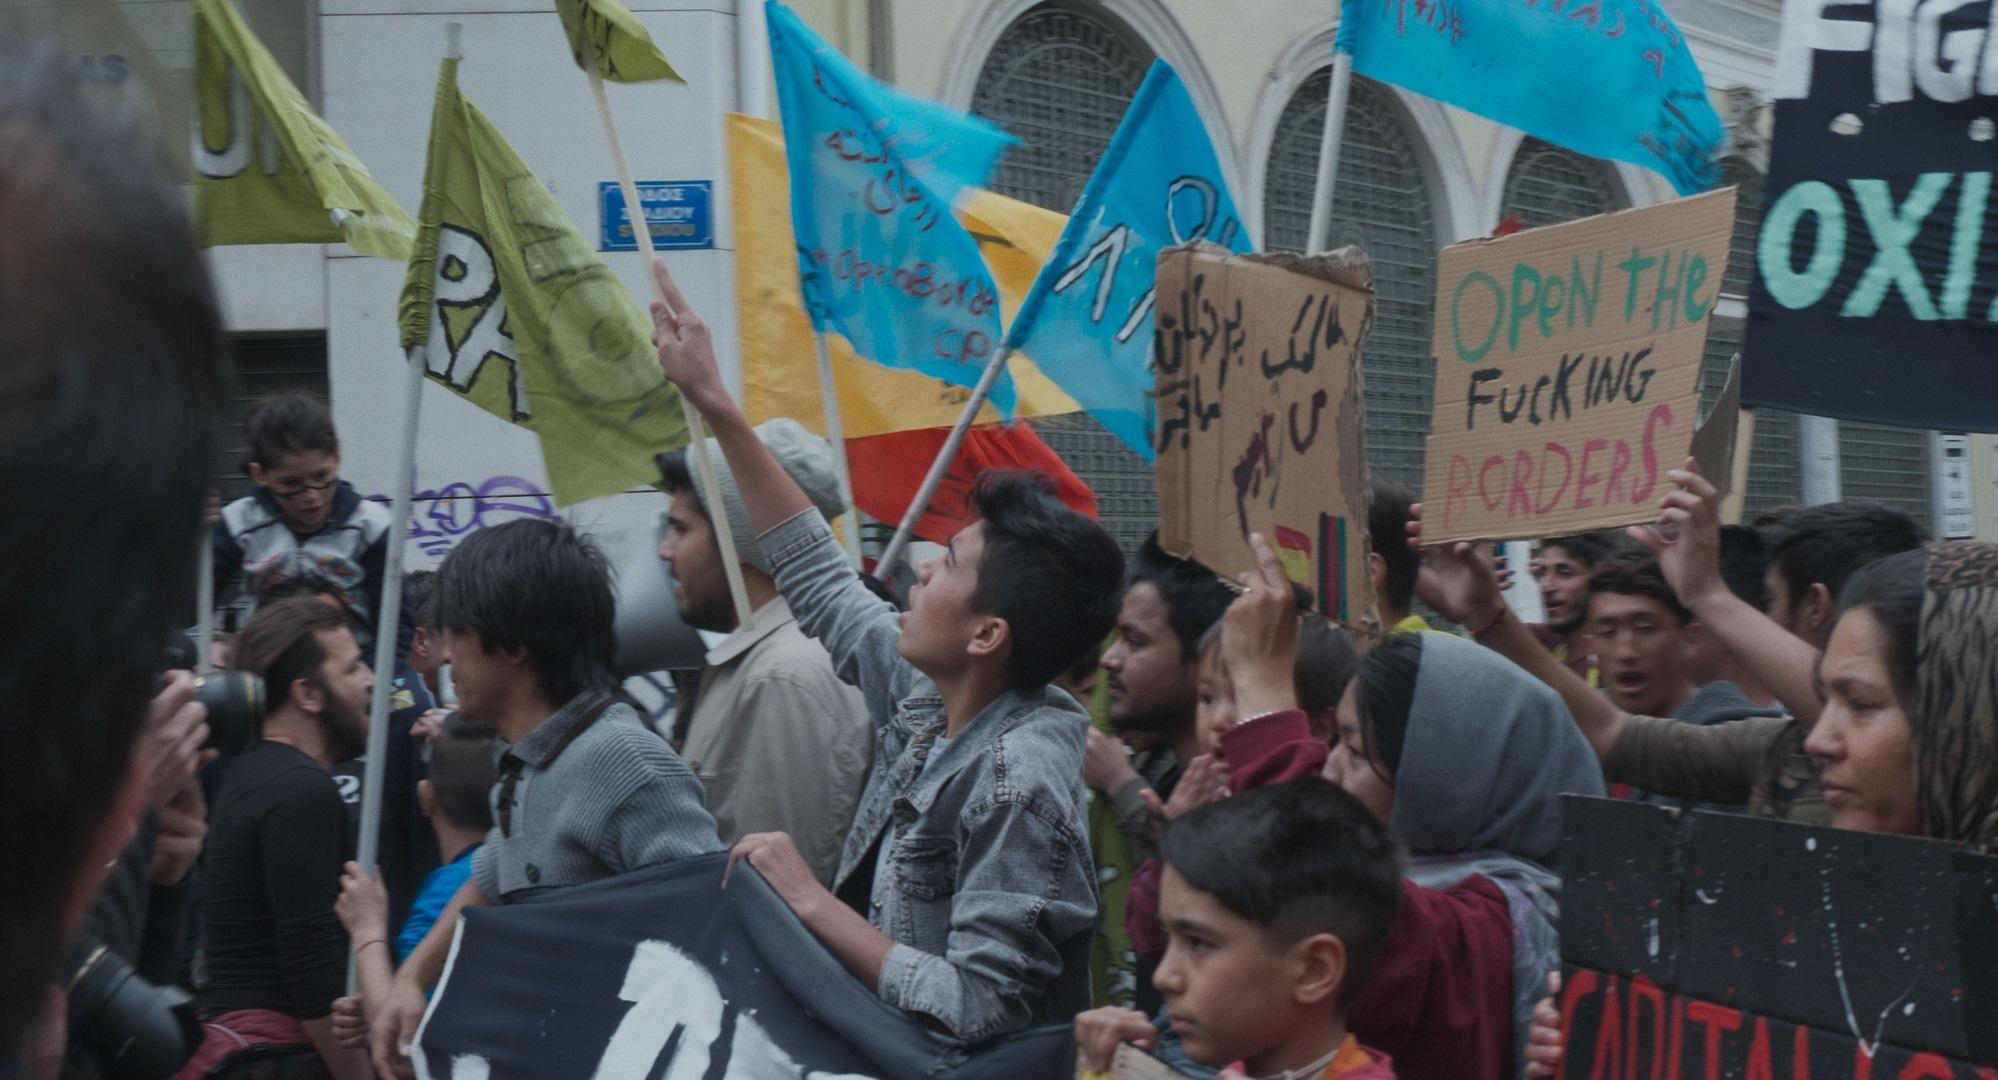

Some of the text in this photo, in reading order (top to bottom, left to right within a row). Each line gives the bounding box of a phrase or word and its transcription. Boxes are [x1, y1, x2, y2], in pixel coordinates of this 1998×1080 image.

[637, 187, 686, 202] ΔΟΣ
[619, 206, 696, 220] ΣΑΔΙΟΥ
[618, 223, 696, 238] SDIOU
